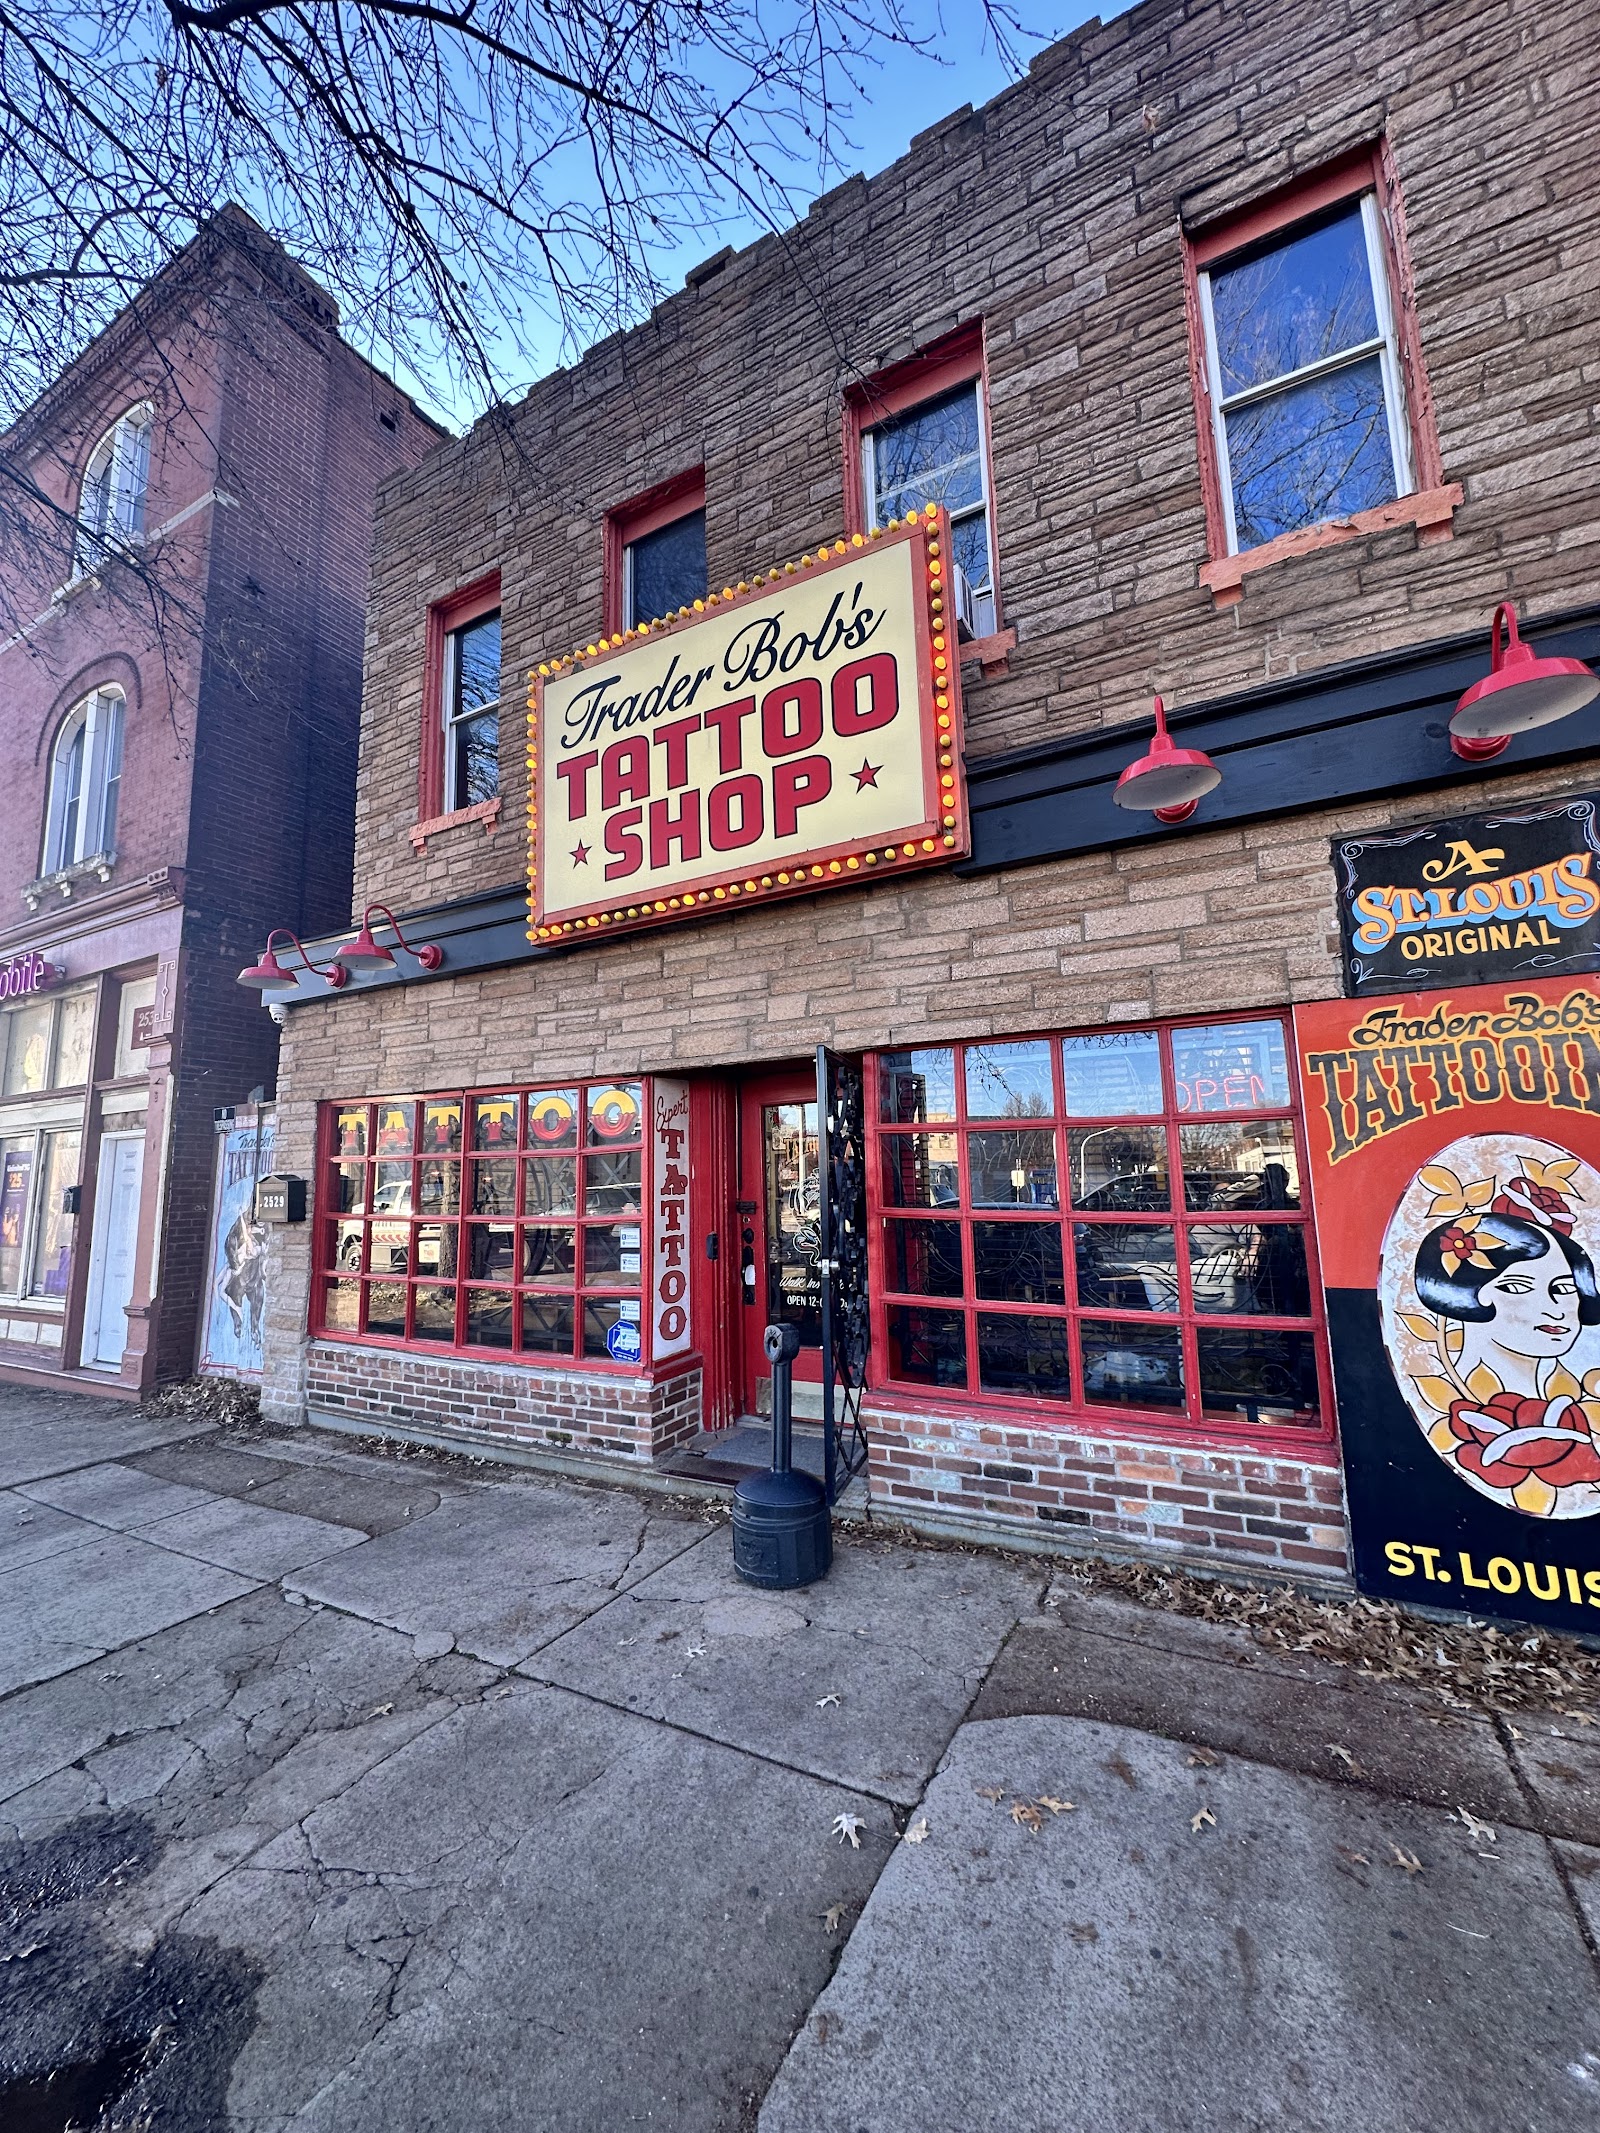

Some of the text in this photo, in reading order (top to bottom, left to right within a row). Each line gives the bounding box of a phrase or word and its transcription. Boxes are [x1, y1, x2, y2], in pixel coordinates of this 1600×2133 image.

[561, 582, 887, 749] Trader Bob's
[557, 653, 899, 822] TATTOO
[605, 755, 832, 882] SHOP
[1422, 840, 1505, 882] A
[1429, 852, 1600, 924] LOUIS
[1401, 920, 1560, 960] ORIGINAL
[1350, 1003, 1490, 1047] Trader
[338, 1090, 638, 1147] TATTOO
[656, 1090, 688, 1132] Expert
[658, 1129, 689, 1341] TATTOO
[787, 1295, 806, 1306] OPEN
[1385, 1541, 1451, 1582] ST.
